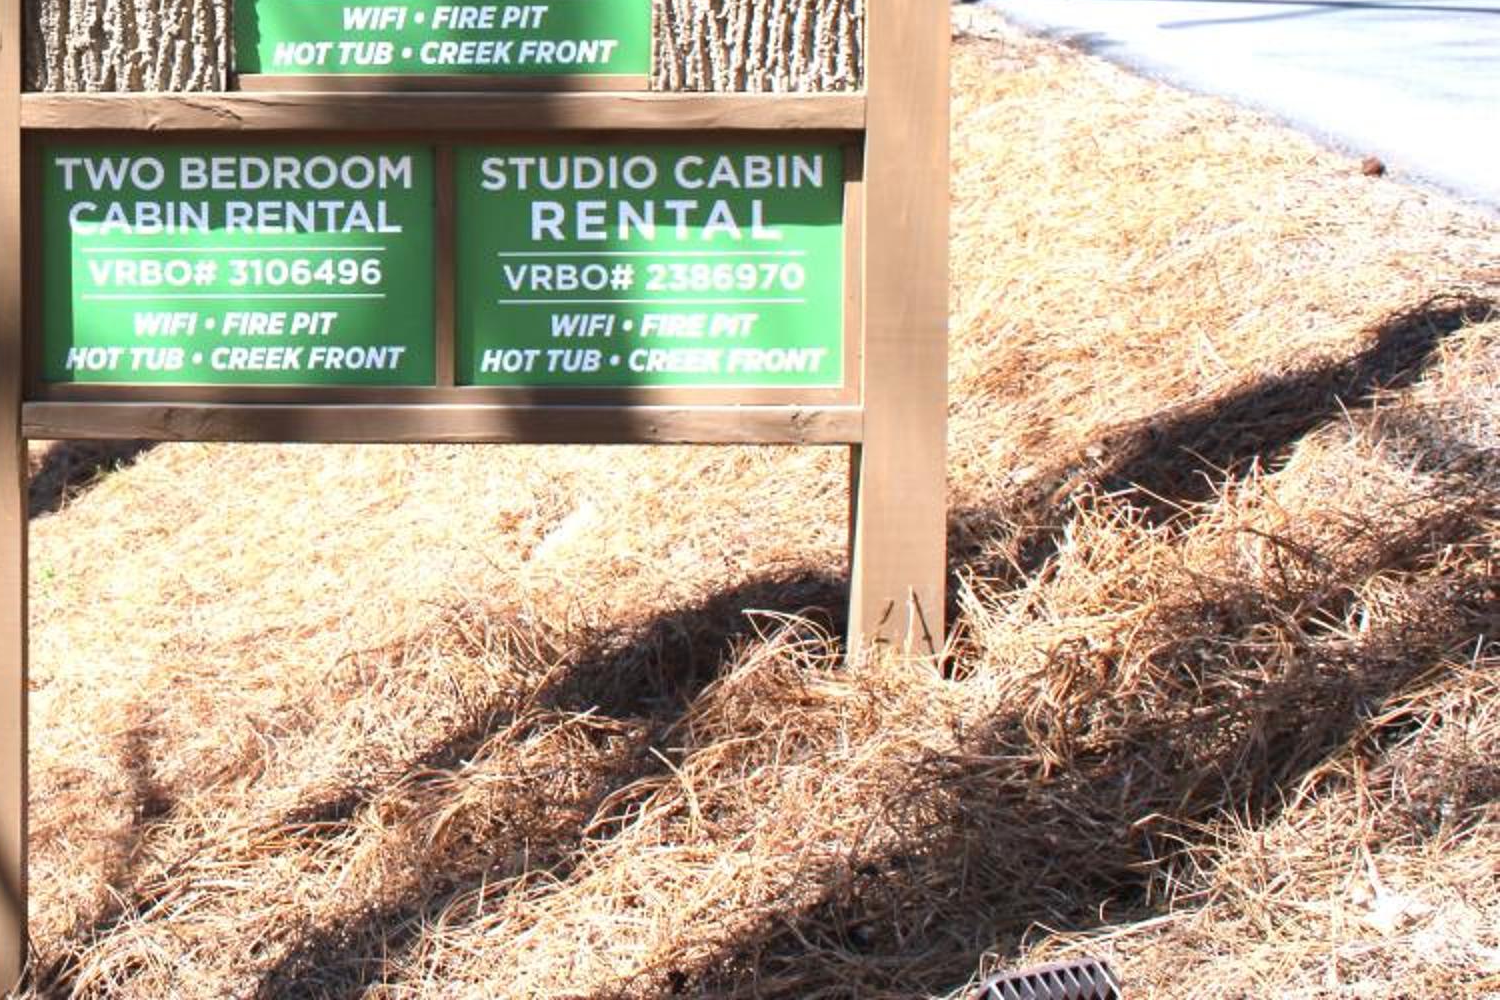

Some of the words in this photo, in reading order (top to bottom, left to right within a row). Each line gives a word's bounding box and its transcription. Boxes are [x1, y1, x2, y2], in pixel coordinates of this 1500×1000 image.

[342, 6, 407, 30] WIFI
[431, 6, 496, 29] FIRE
[501, 5, 549, 29] PIT
[272, 42, 334, 66] HOT
[337, 41, 394, 65] TUB
[420, 40, 514, 65] CREEK
[517, 39, 619, 64] FRONT
[56, 157, 164, 191] TWO
[180, 155, 412, 190] BEDROOM
[481, 156, 657, 190] STUDIO
[674, 155, 823, 189] CABIN
[69, 201, 209, 235] CABIN
[226, 200, 403, 234] RENTAL
[531, 200, 783, 241] RENTAL
[88, 259, 218, 286] VRBO#
[227, 258, 382, 286] 3106496
[503, 264, 635, 291] VRBO#
[645, 263, 805, 291] 2386970
[133, 311, 198, 336] WIFI
[222, 312, 287, 335] FIRE
[290, 311, 337, 335] PIT
[550, 314, 616, 337] WIFI
[640, 314, 706, 337] FIRE
[708, 314, 758, 337] PIT
[66, 348, 125, 371] HOT
[130, 348, 184, 370] TUB
[211, 347, 304, 370] CREEK
[307, 347, 406, 370] FRONT
[481, 350, 542, 372] HOT
[547, 350, 602, 372] TUB
[628, 349, 723, 372] CREEK
[725, 348, 826, 372] FRONT
